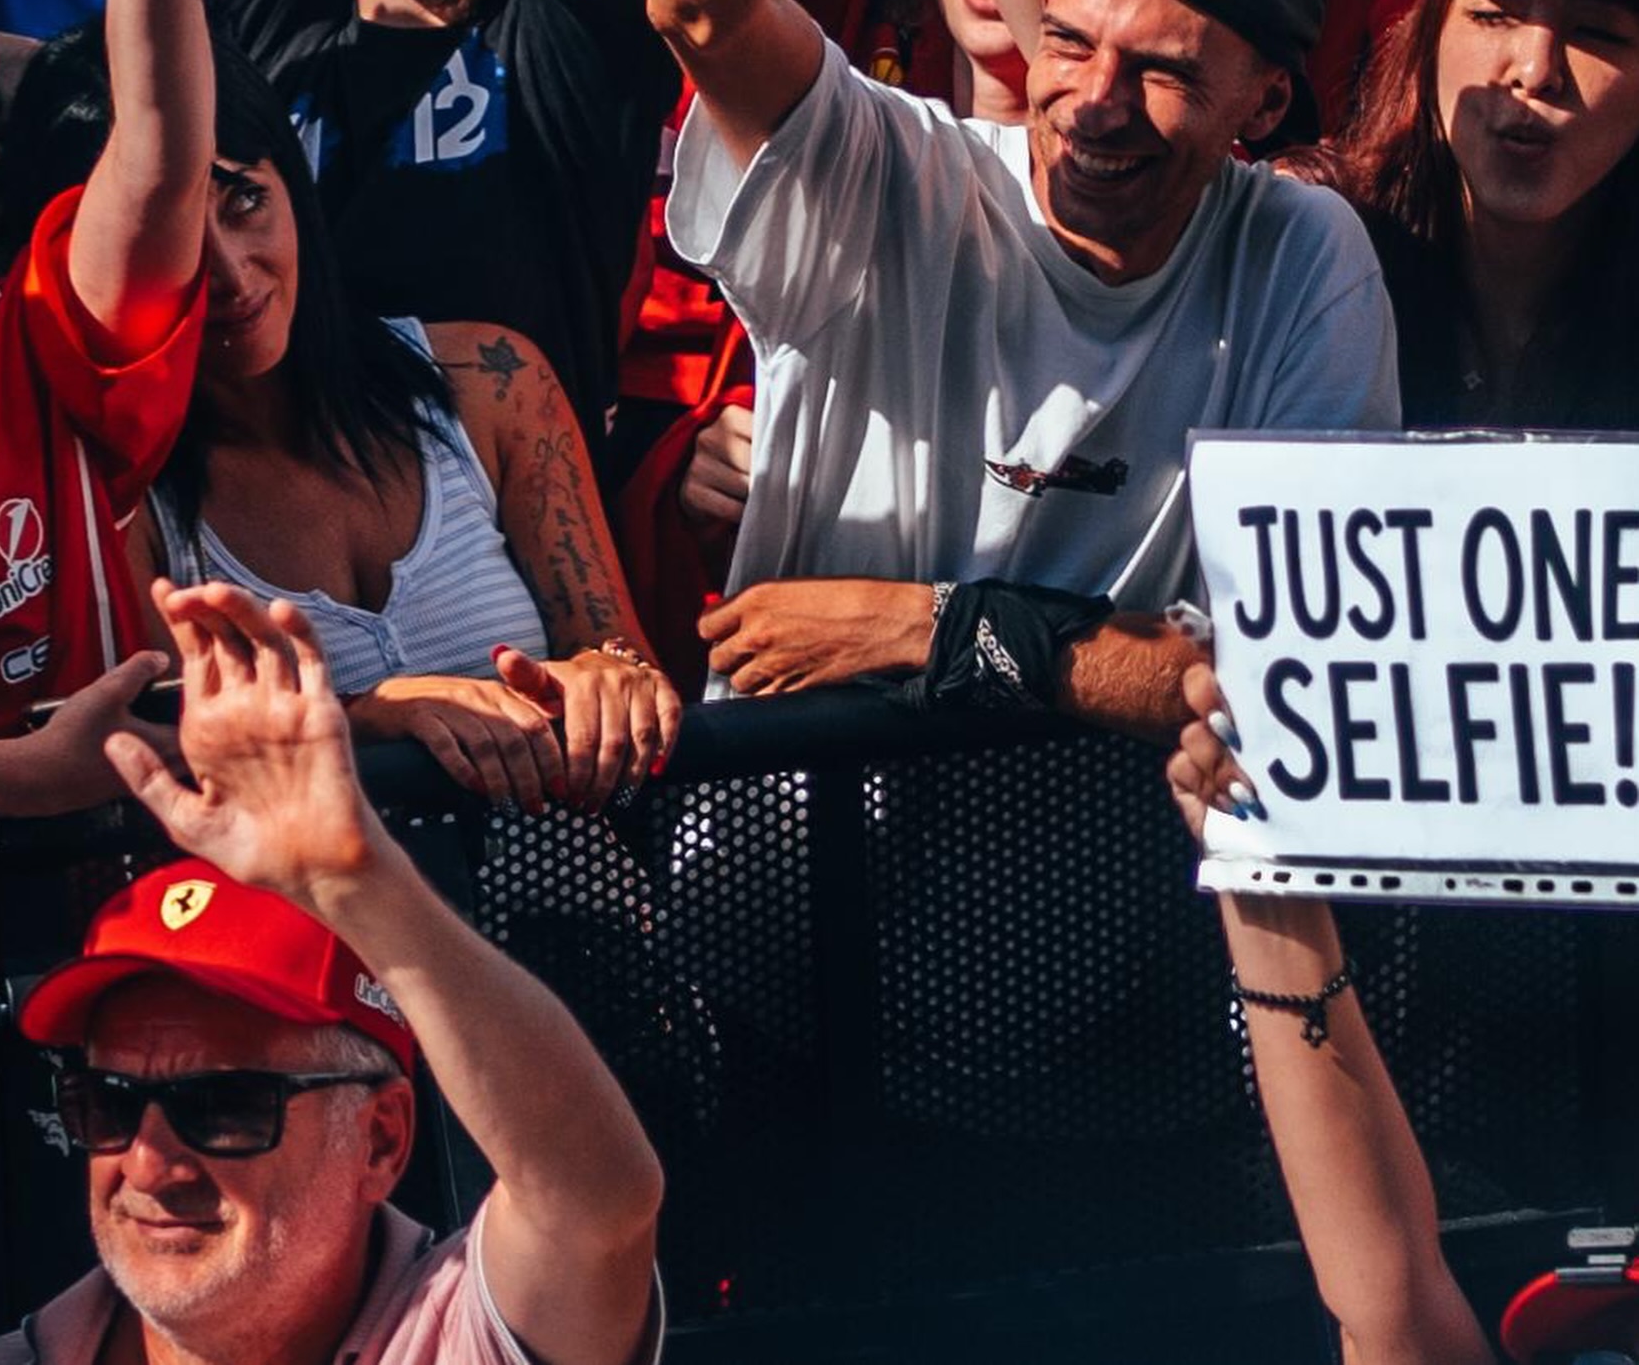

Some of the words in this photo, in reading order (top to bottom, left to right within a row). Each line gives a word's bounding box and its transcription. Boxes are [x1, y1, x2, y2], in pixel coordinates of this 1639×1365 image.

[1234, 505, 1433, 640] JUST
[1461, 507, 1639, 642] ONE
[1263, 657, 1639, 808] SELFIE!
